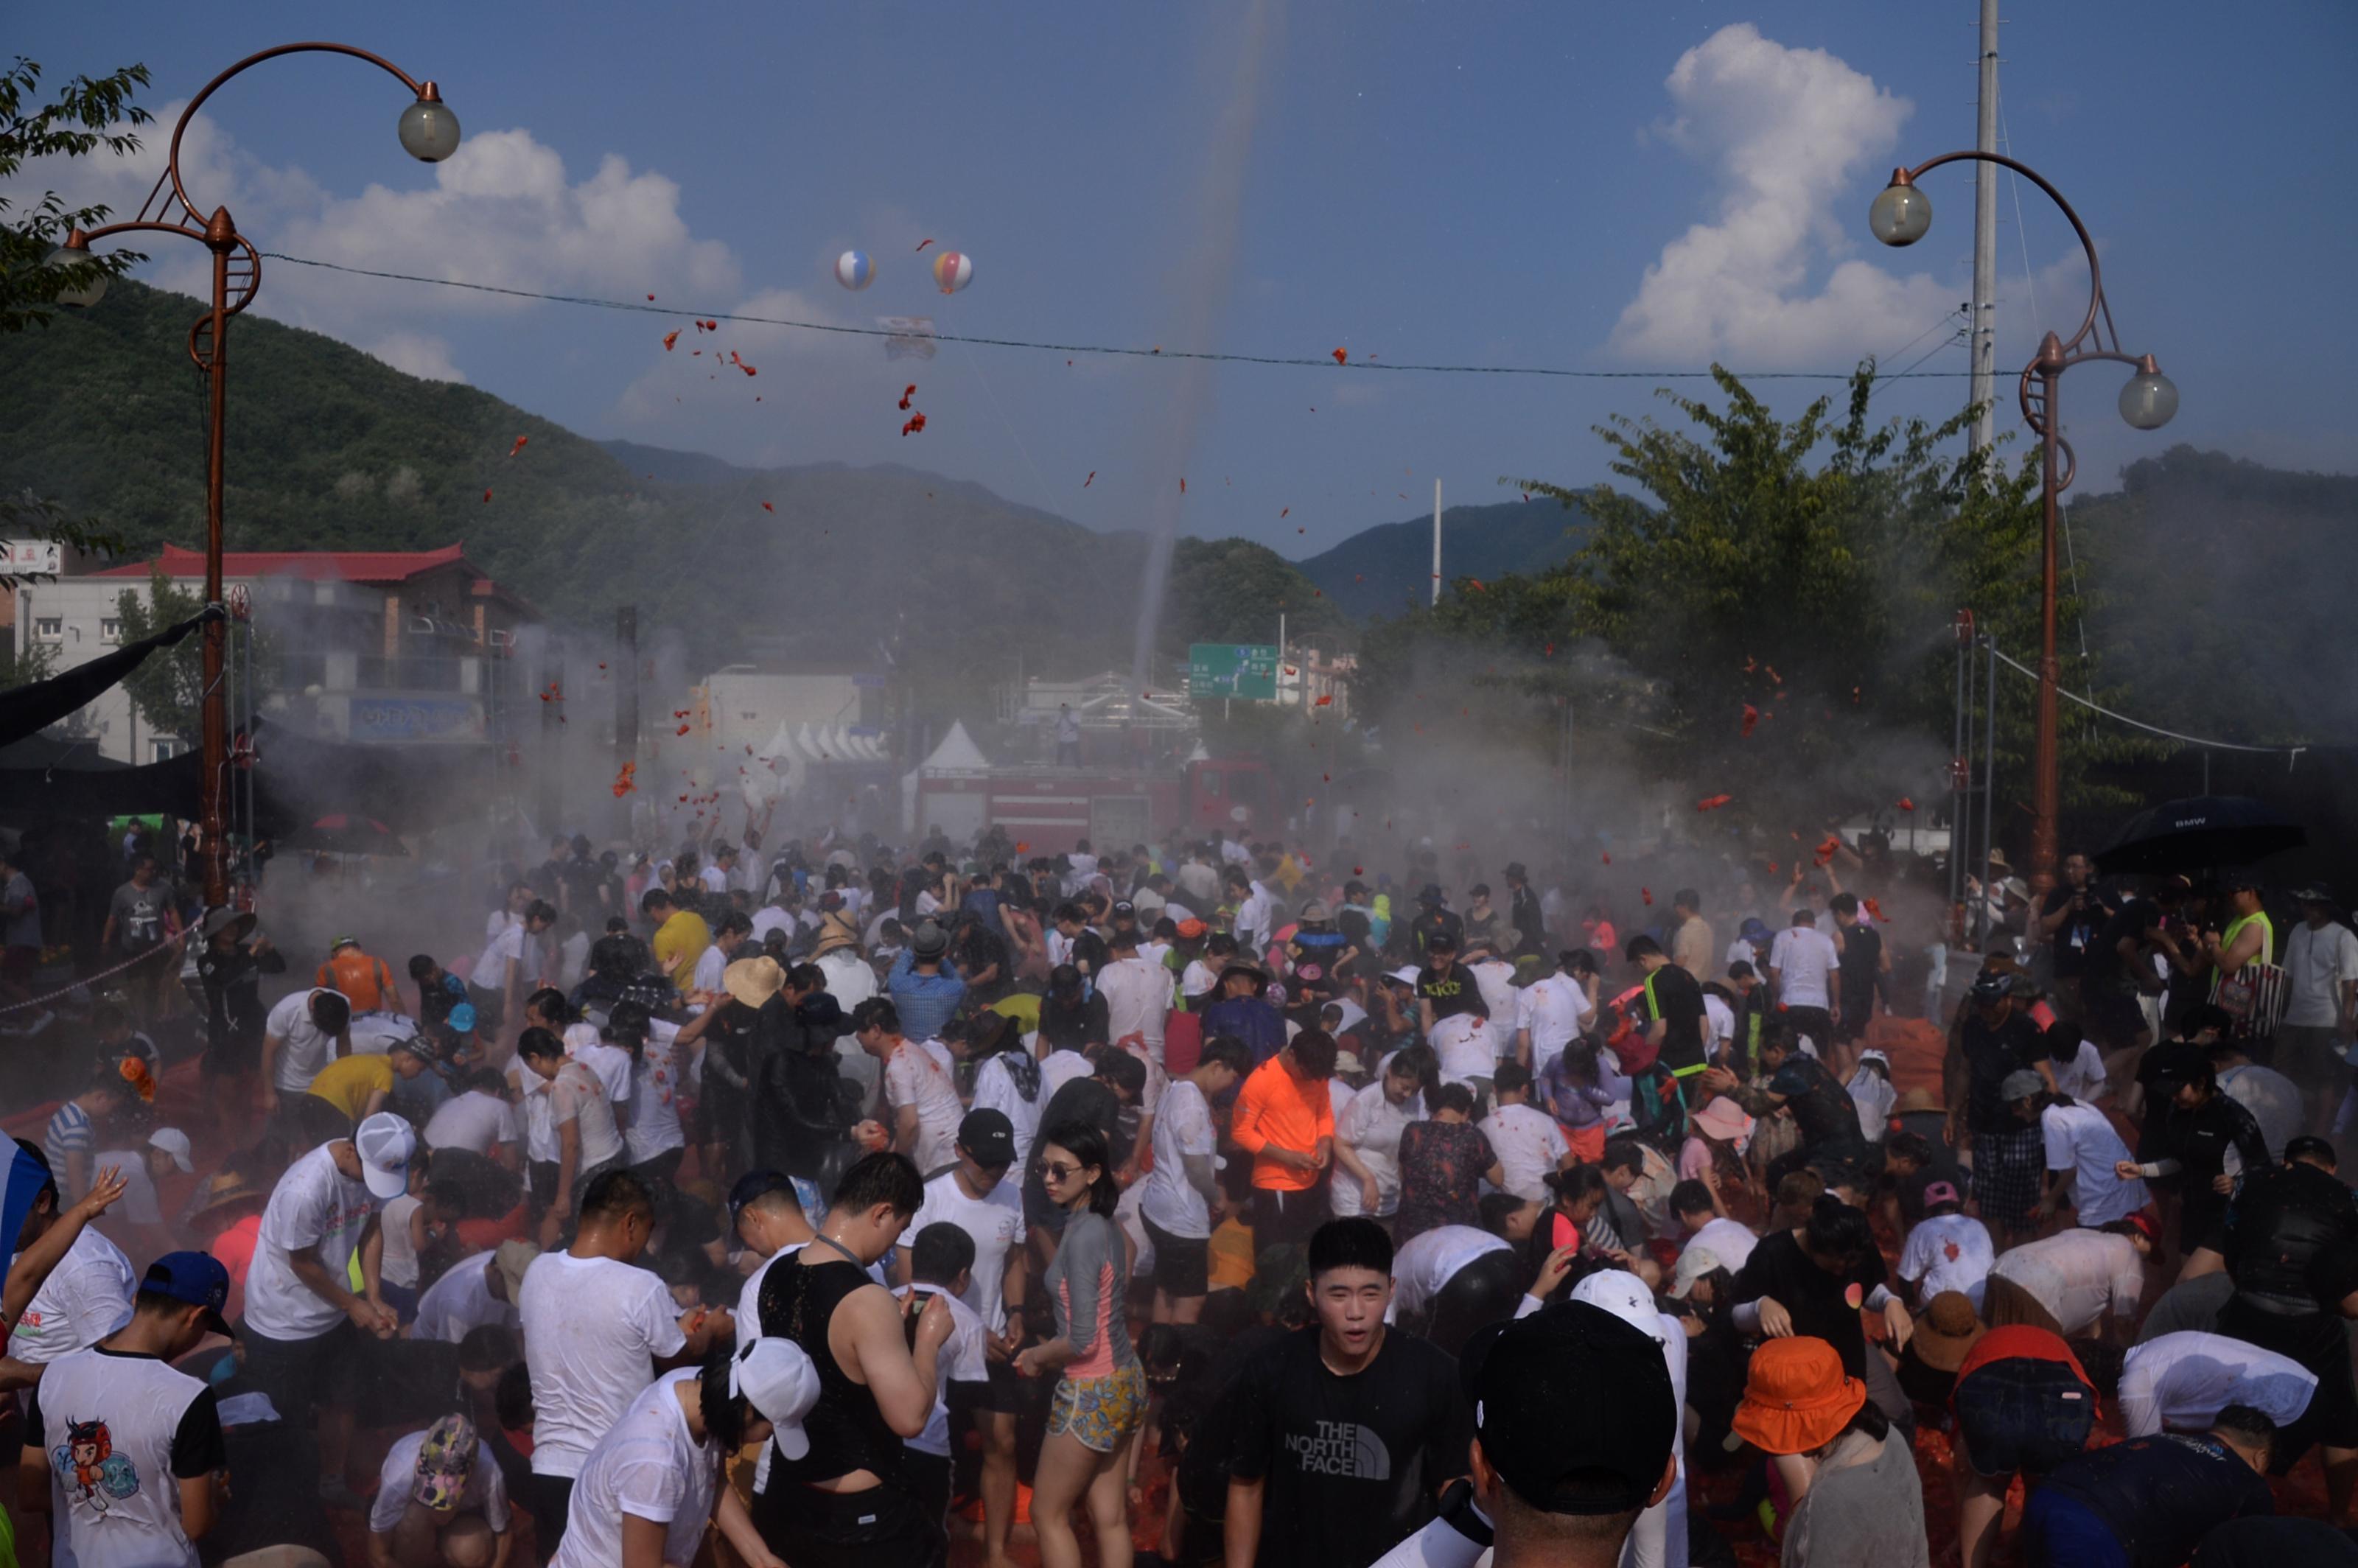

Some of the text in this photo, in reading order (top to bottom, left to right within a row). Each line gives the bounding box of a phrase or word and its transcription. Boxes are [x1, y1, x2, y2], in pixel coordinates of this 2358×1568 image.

[2175, 816, 2205, 828] BMW
[1315, 1420, 1356, 1441] THE
[1285, 1433, 1354, 1457] NORTH
[1301, 1455, 1353, 1476] FACE
